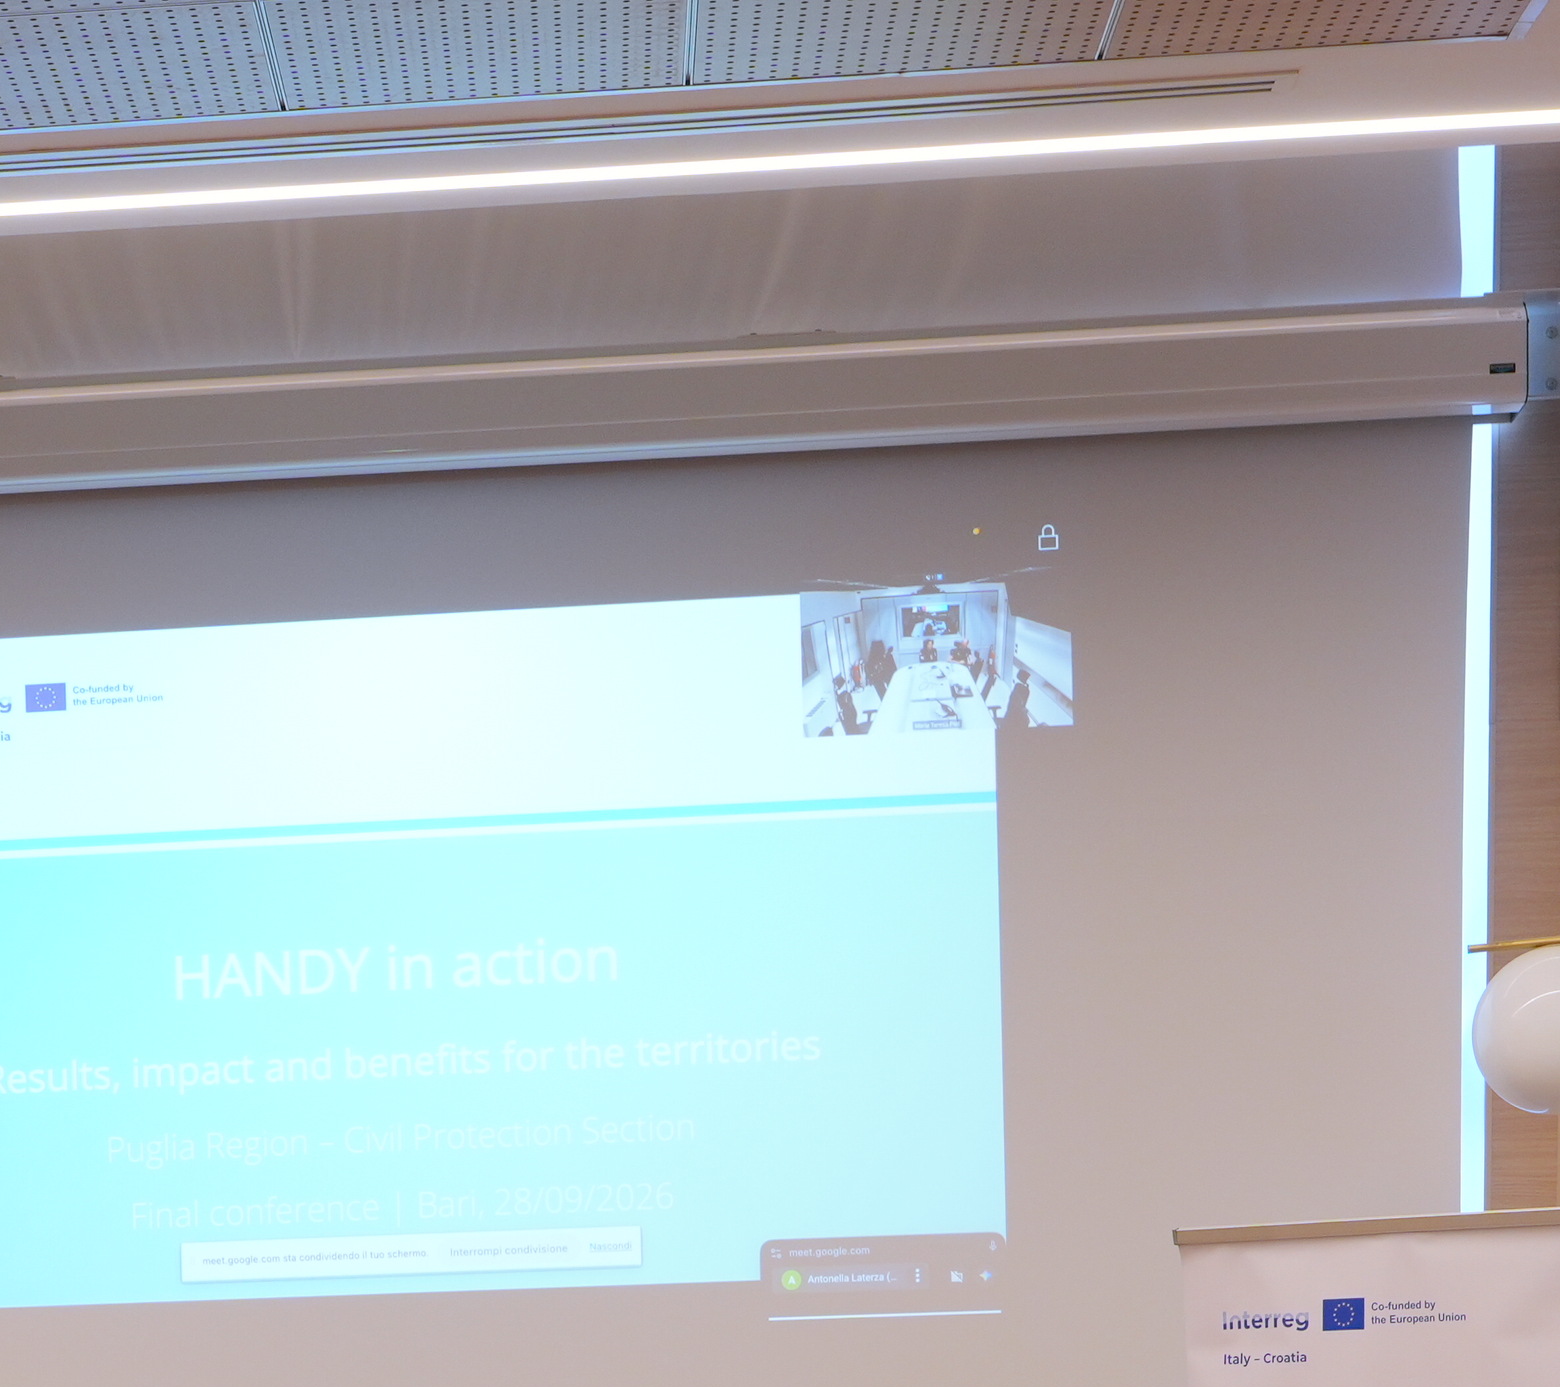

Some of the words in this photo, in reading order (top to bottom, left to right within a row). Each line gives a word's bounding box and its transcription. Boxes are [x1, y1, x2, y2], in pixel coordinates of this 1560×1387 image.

[72, 684, 120, 694] Co-funded
[123, 683, 134, 693] by
[73, 698, 87, 706] the
[90, 696, 134, 706] European
[136, 694, 164, 702] Union
[174, 947, 370, 1000] HANDY
[387, 944, 434, 991] in
[452, 937, 619, 988] action
[132, 1053, 255, 1095] impact
[265, 1048, 332, 1083] and
[345, 1043, 491, 1080] benefits
[502, 1039, 555, 1073] for
[566, 1037, 625, 1069] the
[635, 1029, 822, 1067] territories
[107, 1131, 196, 1171] Puglia
[206, 1130, 308, 1167] Region
[343, 1122, 403, 1155] Civil
[414, 1119, 572, 1152] Protection
[583, 1113, 695, 1145] Section
[131, 1198, 199, 1231] Final
[210, 1194, 380, 1228] conference
[417, 1187, 488, 1220] Bari,
[494, 1181, 675, 1217] 28/09/2026
[202, 1255, 280, 1266] meet.google.com
[299, 1251, 360, 1262] condividendo
[450, 1246, 502, 1258] Interrompi
[505, 1244, 568, 1256] condivisione
[589, 1240, 632, 1251] Nascondi
[789, 1247, 870, 1258] meet.google.com
[808, 1273, 849, 1283] Antonella
[852, 1273, 884, 1283] Laterza
[1371, 1301, 1421, 1311] Co-funded
[1424, 1300, 1436, 1311] by
[1222, 1311, 1310, 1331] Interreg
[1371, 1315, 1387, 1324] the
[1389, 1314, 1435, 1325] European
[1438, 1312, 1467, 1322] Union
[1223, 1353, 1251, 1367] Italy
[1263, 1351, 1307, 1364] Croatia
